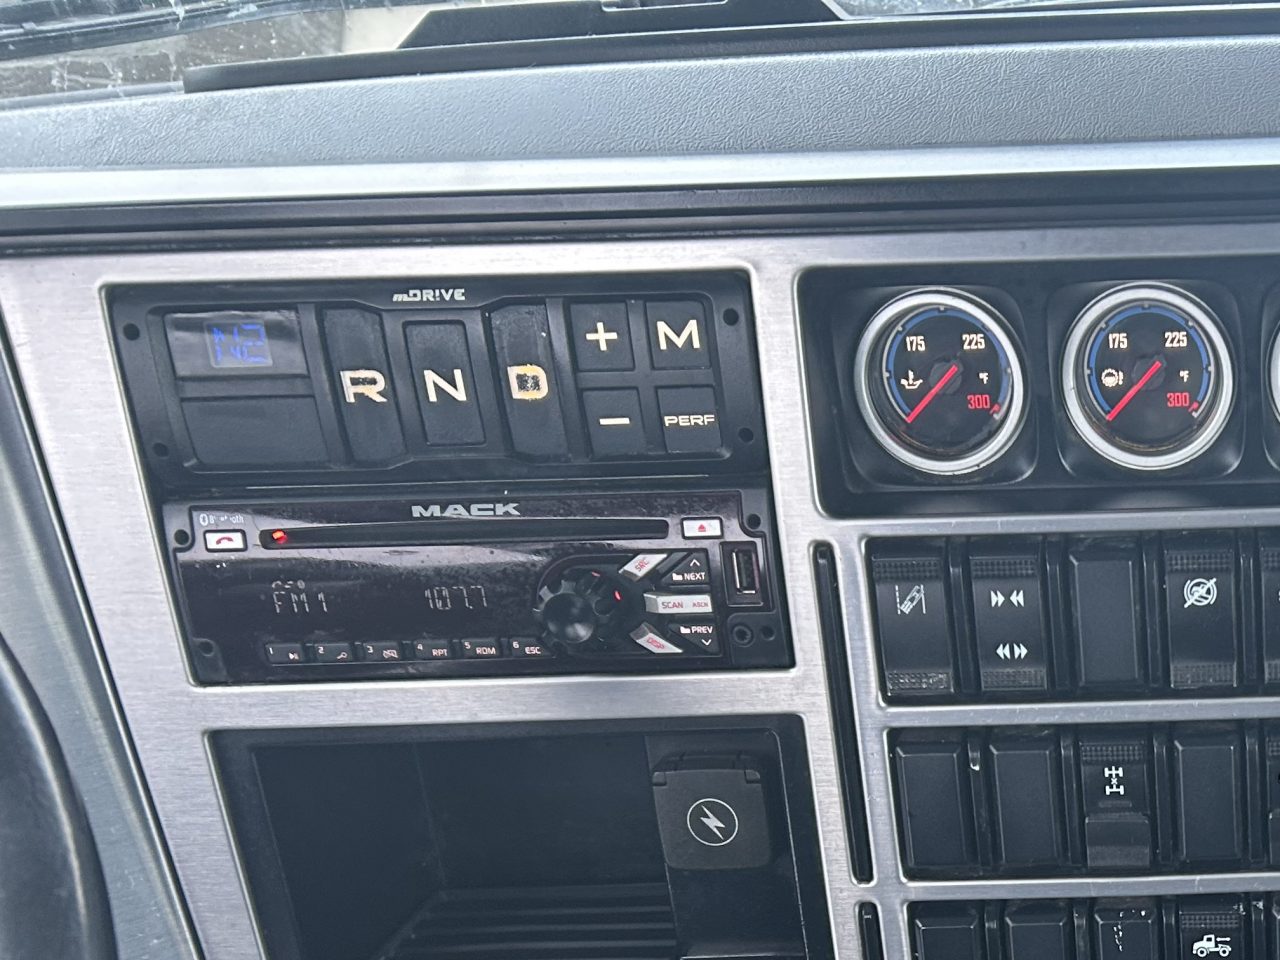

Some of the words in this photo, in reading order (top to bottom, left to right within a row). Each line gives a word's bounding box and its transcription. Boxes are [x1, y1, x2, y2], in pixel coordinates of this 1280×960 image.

[656, 319, 701, 350] M
[1108, 333, 1128, 349] 175
[1164, 331, 1188, 348] 225
[905, 335, 926, 352] 175
[962, 333, 985, 350] 225
[340, 369, 387, 403] R
[423, 368, 467, 402] N
[507, 364, 549, 399] D
[967, 394, 991, 409] 300
[1166, 393, 1190, 408] 300
[663, 414, 715, 427] PERF
[411, 503, 521, 518] MACK
[684, 572, 706, 580] NEXT
[661, 601, 684, 609] SCAN
[691, 626, 713, 634] PREV
[432, 648, 448, 657] RPT
[525, 646, 541, 655] ESC
